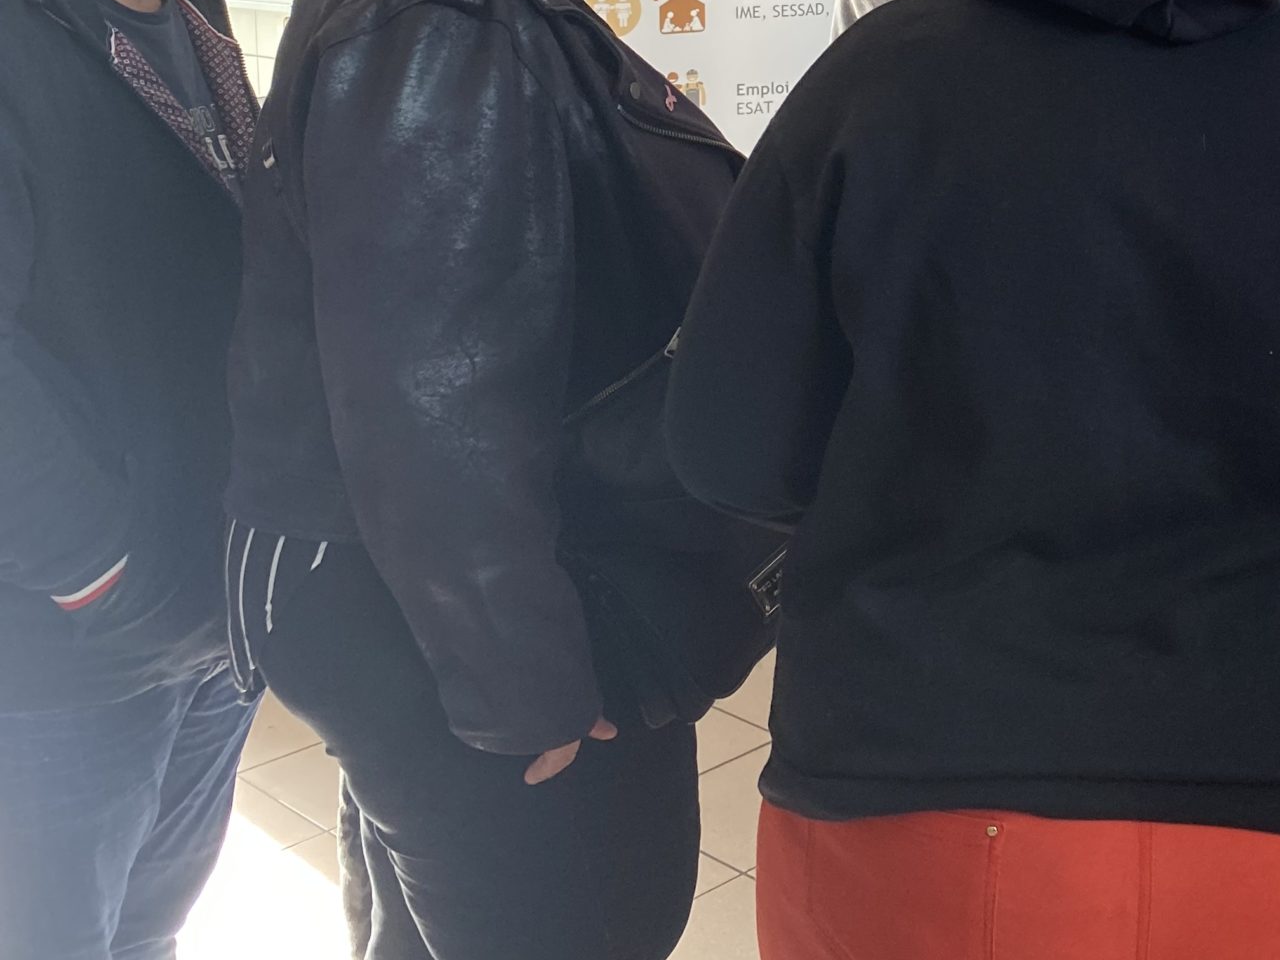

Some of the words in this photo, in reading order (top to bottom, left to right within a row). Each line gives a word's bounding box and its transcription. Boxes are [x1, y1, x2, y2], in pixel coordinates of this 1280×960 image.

[736, 5, 766, 20] IME,
[773, 3, 829, 19] SESSAD,
[737, 81, 789, 98] Emploi
